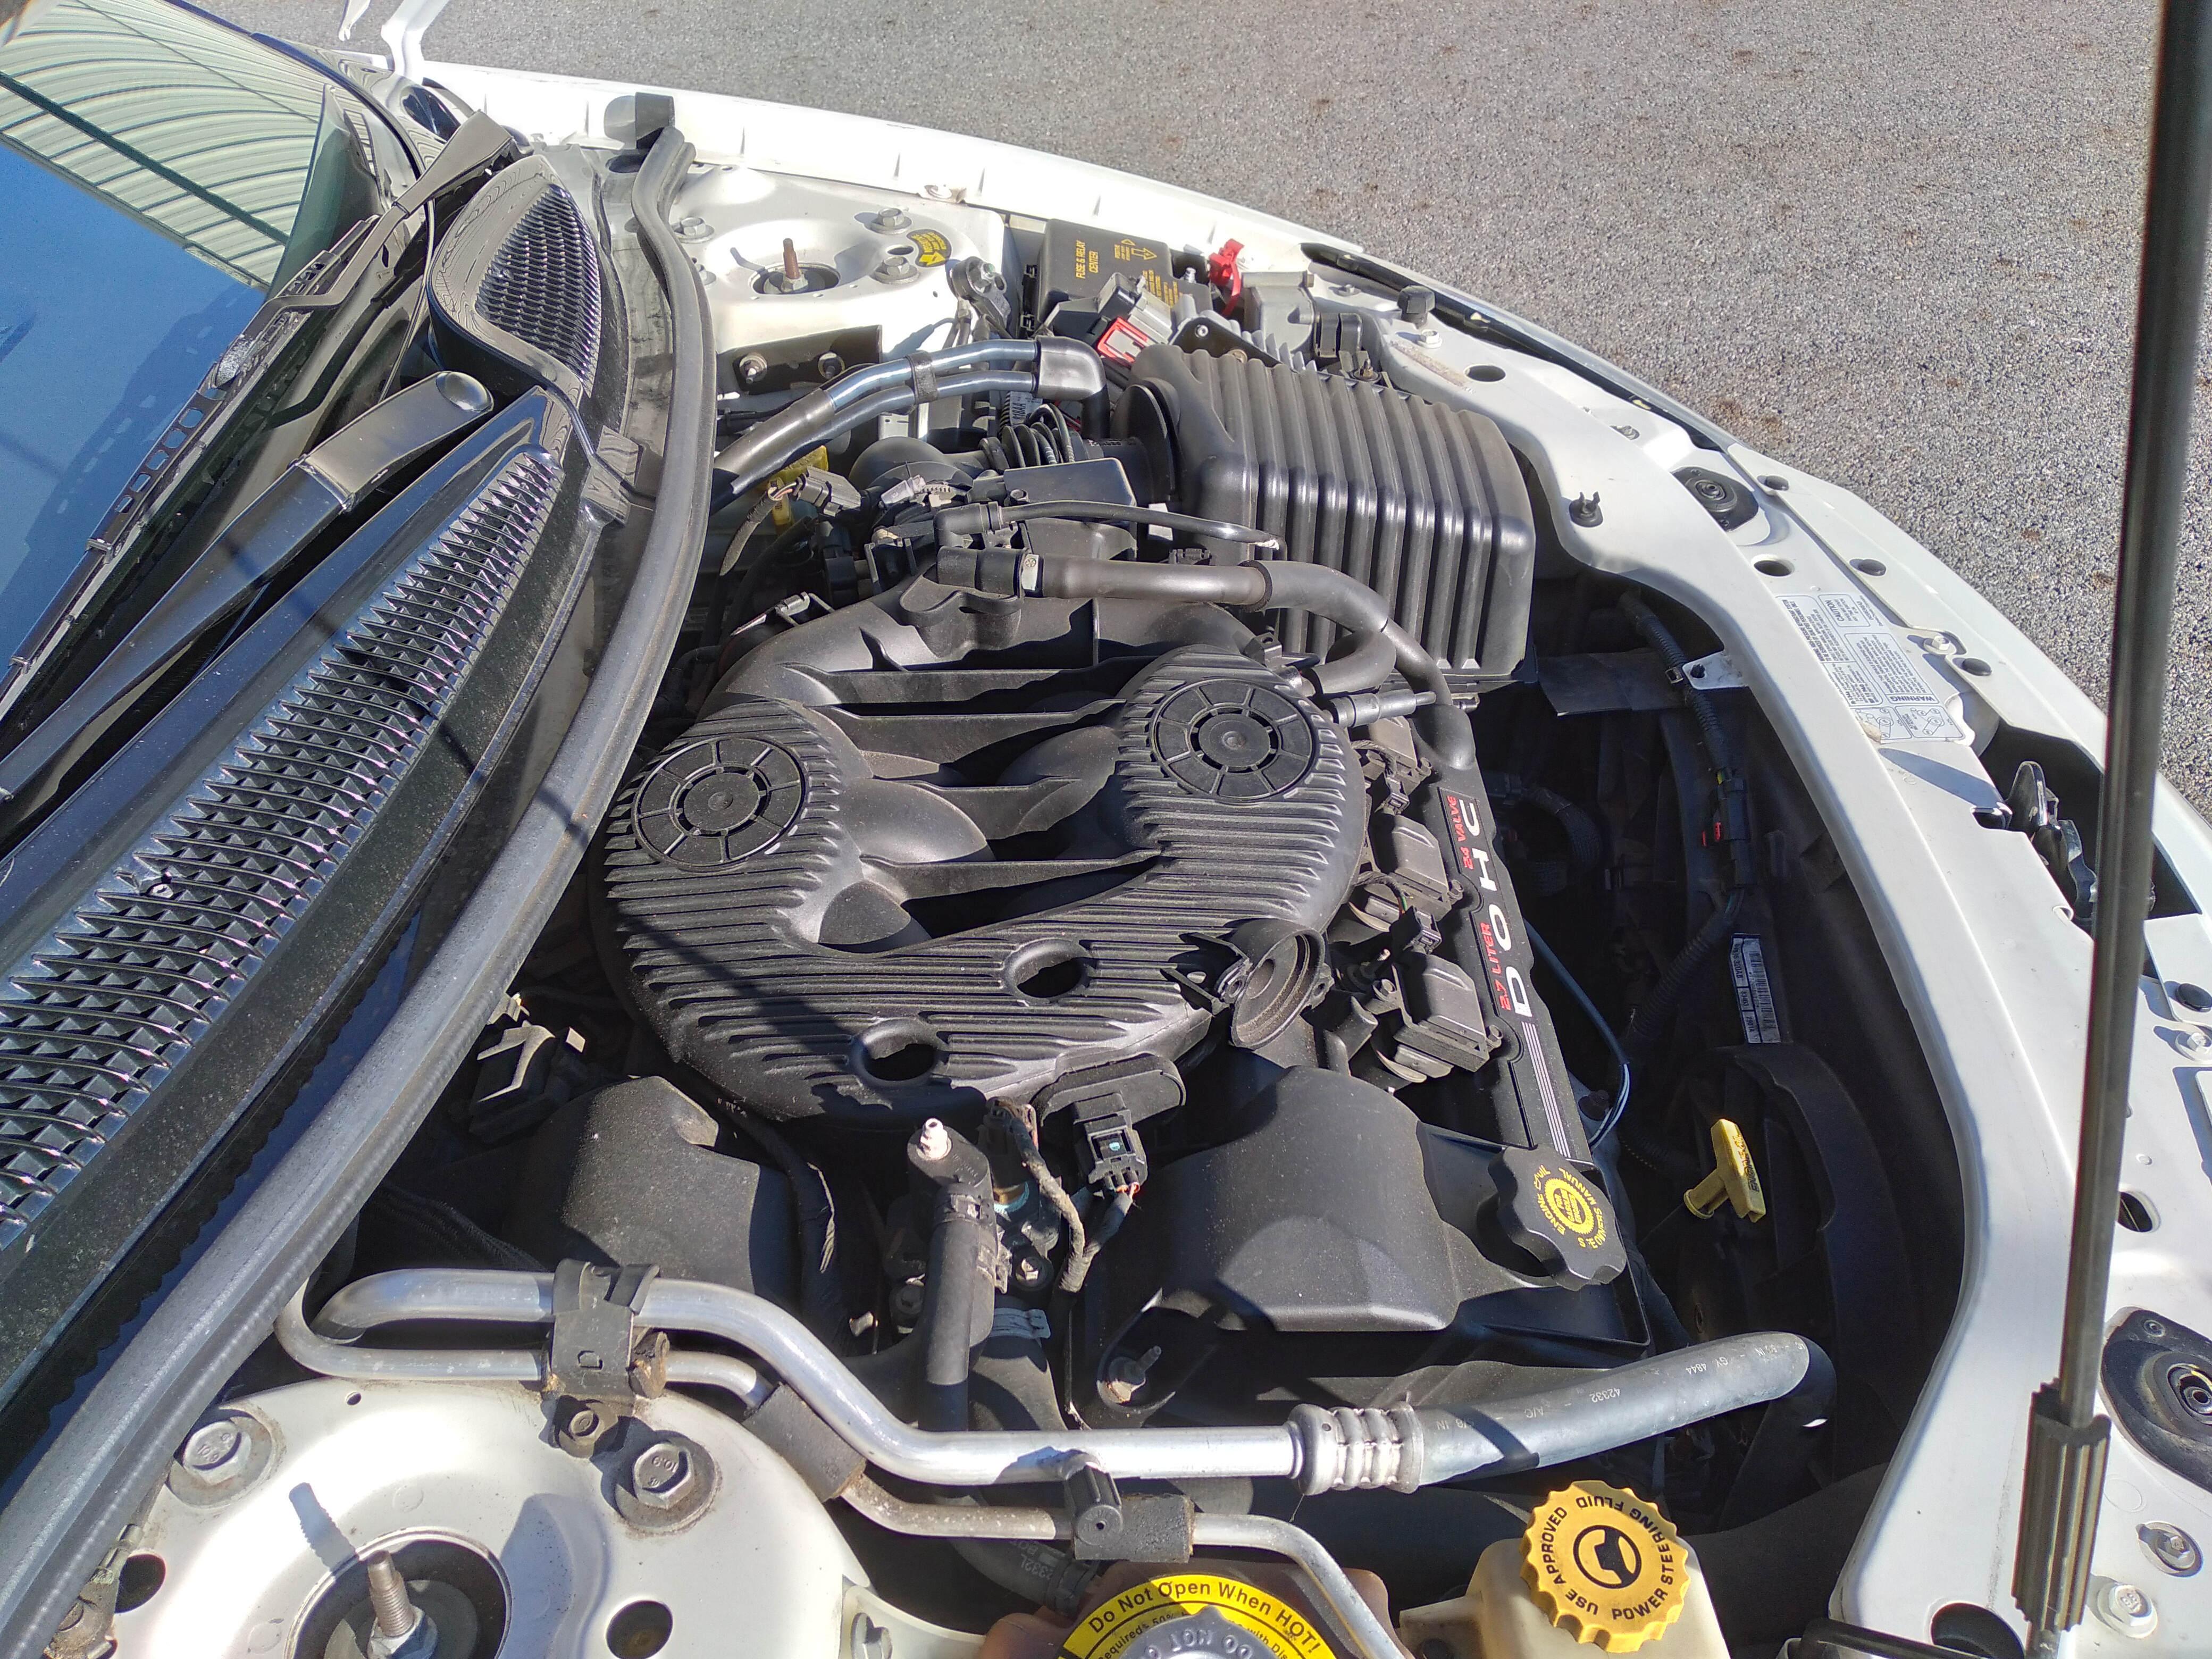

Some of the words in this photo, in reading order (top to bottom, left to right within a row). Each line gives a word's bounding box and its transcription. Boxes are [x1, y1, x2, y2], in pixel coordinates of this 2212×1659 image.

[1075, 240, 1086, 258] RELAY
[1088, 250, 1099, 273] CENTER
[1075, 262, 1086, 279] FUSE
[1825, 600, 1844, 621] CAUTION
[1447, 795, 1465, 842] VALVE
[1463, 847, 1474, 870] 24
[1459, 798, 1532, 1017] DOHC
[1480, 922, 1502, 975] LITER
[1495, 979, 1512, 1010] 2.7
[1558, 1167, 1597, 1205] MANUAL
[1537, 1194, 1566, 1235] ENGINE
[1686, 1363, 1708, 1375] 4844
[1589, 1387, 1621, 1403] 42332
[651, 1455, 678, 1473] 10.9
[1576, 1495, 1624, 1509] FLUID
[1541, 1506, 1568, 1585] APPROVED
[1629, 1508, 1674, 1585] STEERING
[1565, 1588, 1598, 1615] USE
[1612, 1587, 1669, 1620] POWER
[1088, 1609, 1116, 1633] Do
[1117, 1587, 1153, 1613] Not
[1158, 1581, 1211, 1598] Open
[1218, 1581, 1272, 1616] When
[1276, 1610, 1322, 1654] HOT!
